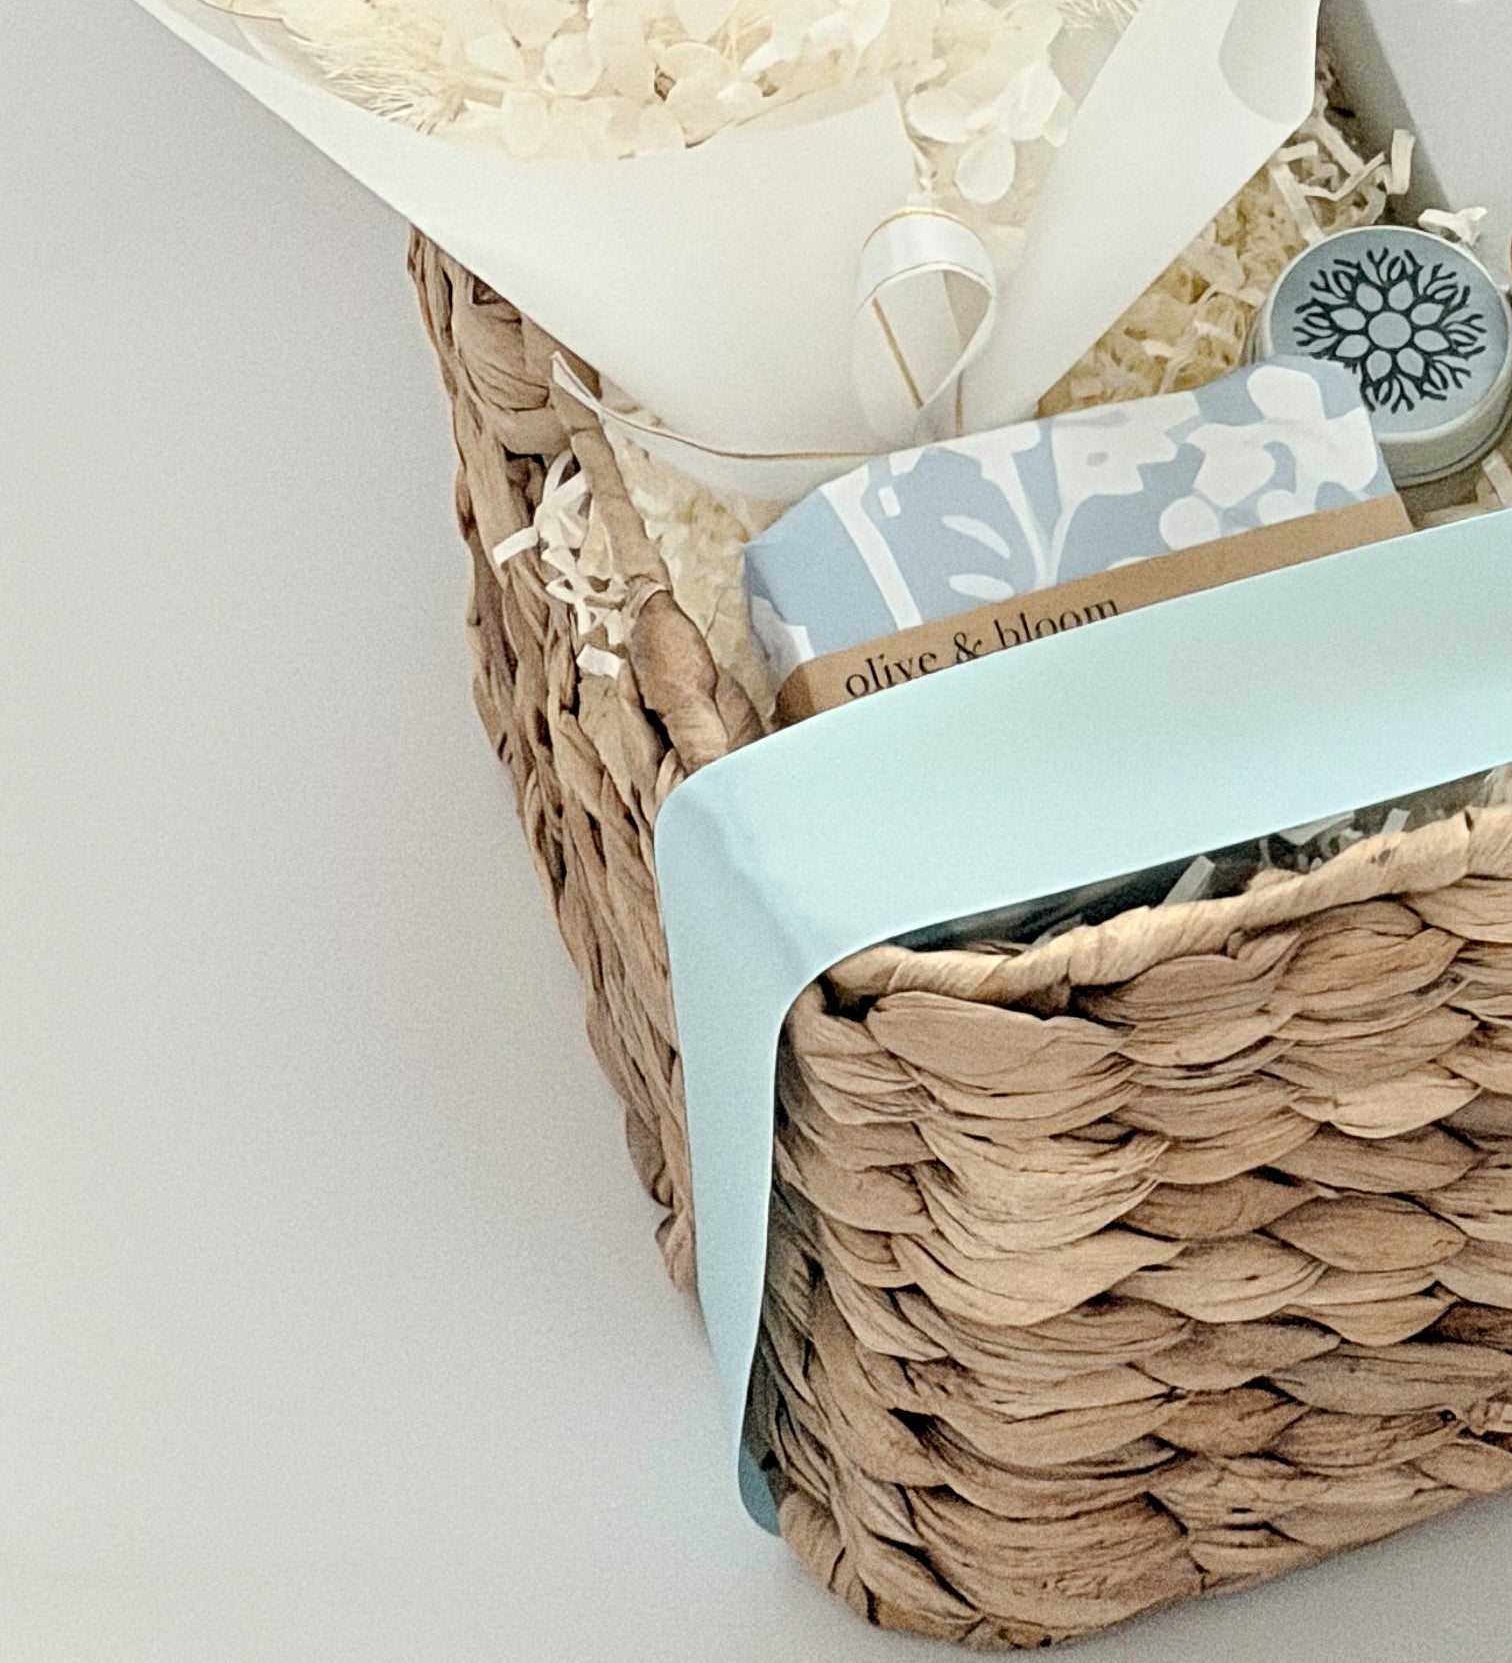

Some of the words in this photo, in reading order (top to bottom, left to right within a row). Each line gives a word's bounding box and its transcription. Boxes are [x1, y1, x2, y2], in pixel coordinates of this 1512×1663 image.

[845, 651, 940, 698] olive
[954, 631, 983, 665] &
[994, 599, 1120, 649] bloom
